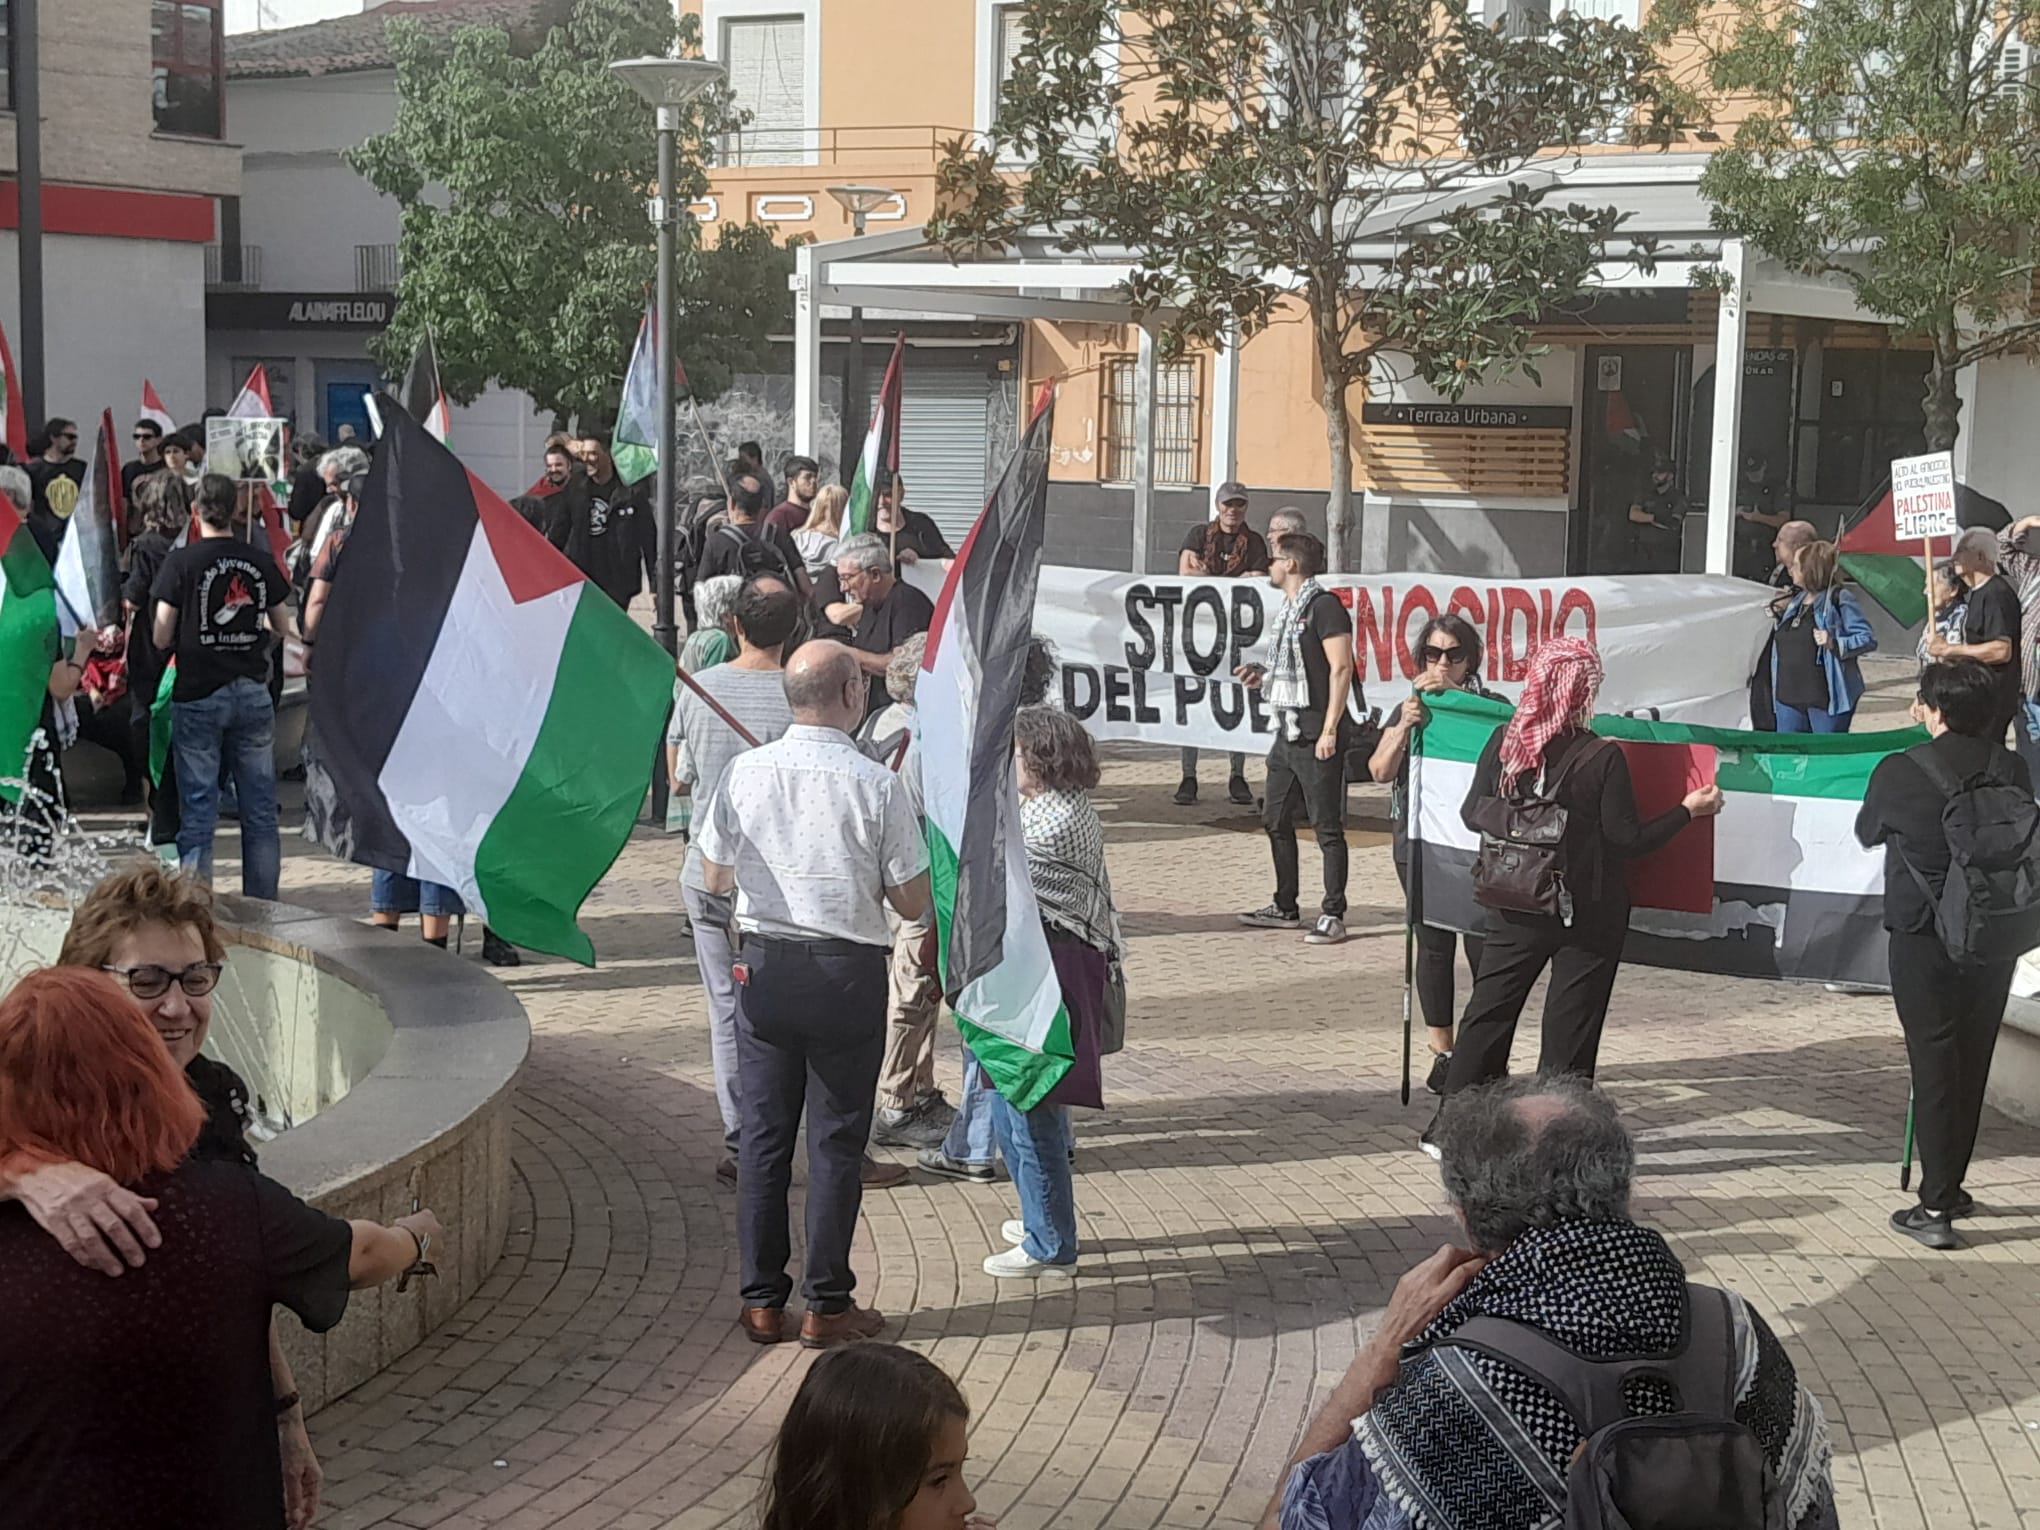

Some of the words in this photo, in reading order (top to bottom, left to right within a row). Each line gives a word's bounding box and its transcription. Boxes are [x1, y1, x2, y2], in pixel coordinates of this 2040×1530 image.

[1407, 407, 1459, 424] Terraza
[1464, 408, 1517, 425] Urbana
[1897, 491, 1952, 516] PALESTINA
[1905, 513, 1947, 536] LIBRE
[1124, 583, 1265, 676] STOP
[1331, 584, 1597, 682] NOCIDIO
[1062, 663, 1161, 724] DEL
[1174, 673, 1273, 734] PUE
